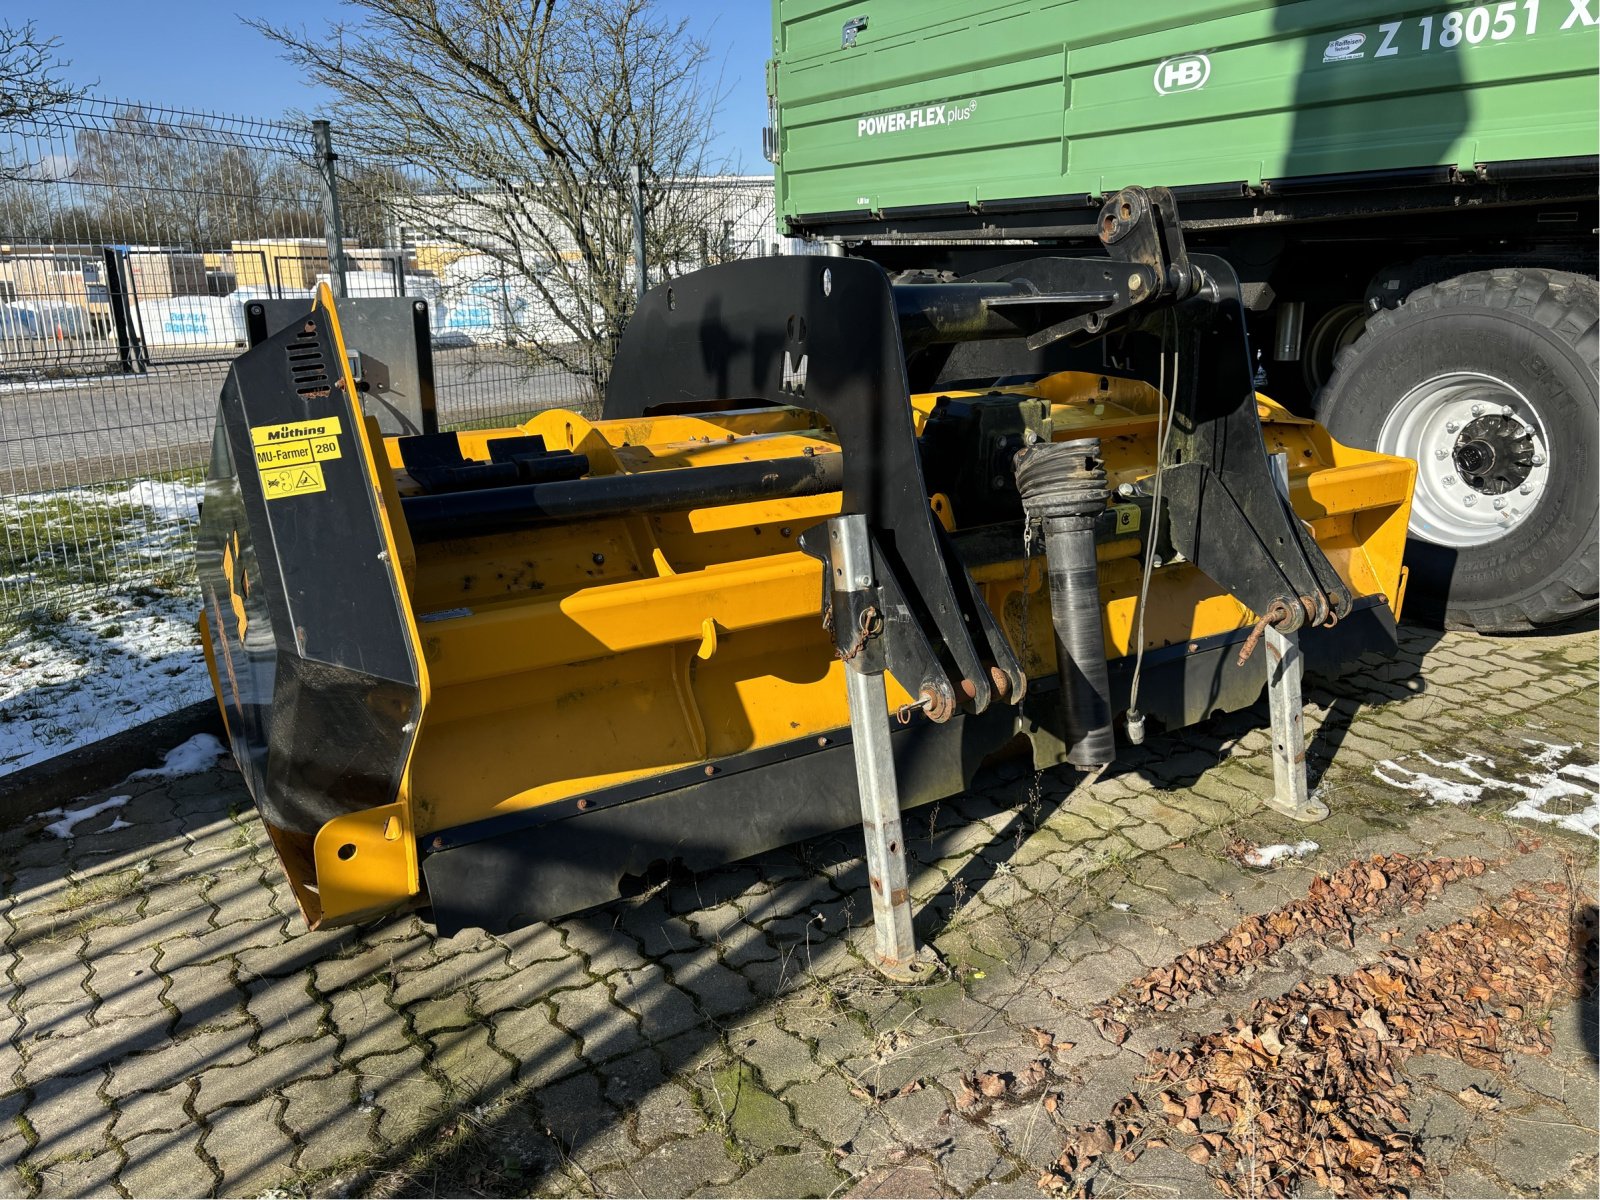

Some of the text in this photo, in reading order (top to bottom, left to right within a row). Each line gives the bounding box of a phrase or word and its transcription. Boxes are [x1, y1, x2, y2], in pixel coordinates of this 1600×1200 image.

[1374, 0, 1599, 58] Z 18051 X
[1335, 38, 1362, 47] Raiffeisen
[858, 105, 971, 137] POWER-FLEX plus
[267, 426, 326, 440] Müthing
[257, 442, 336, 463] MU-Farmer 280
